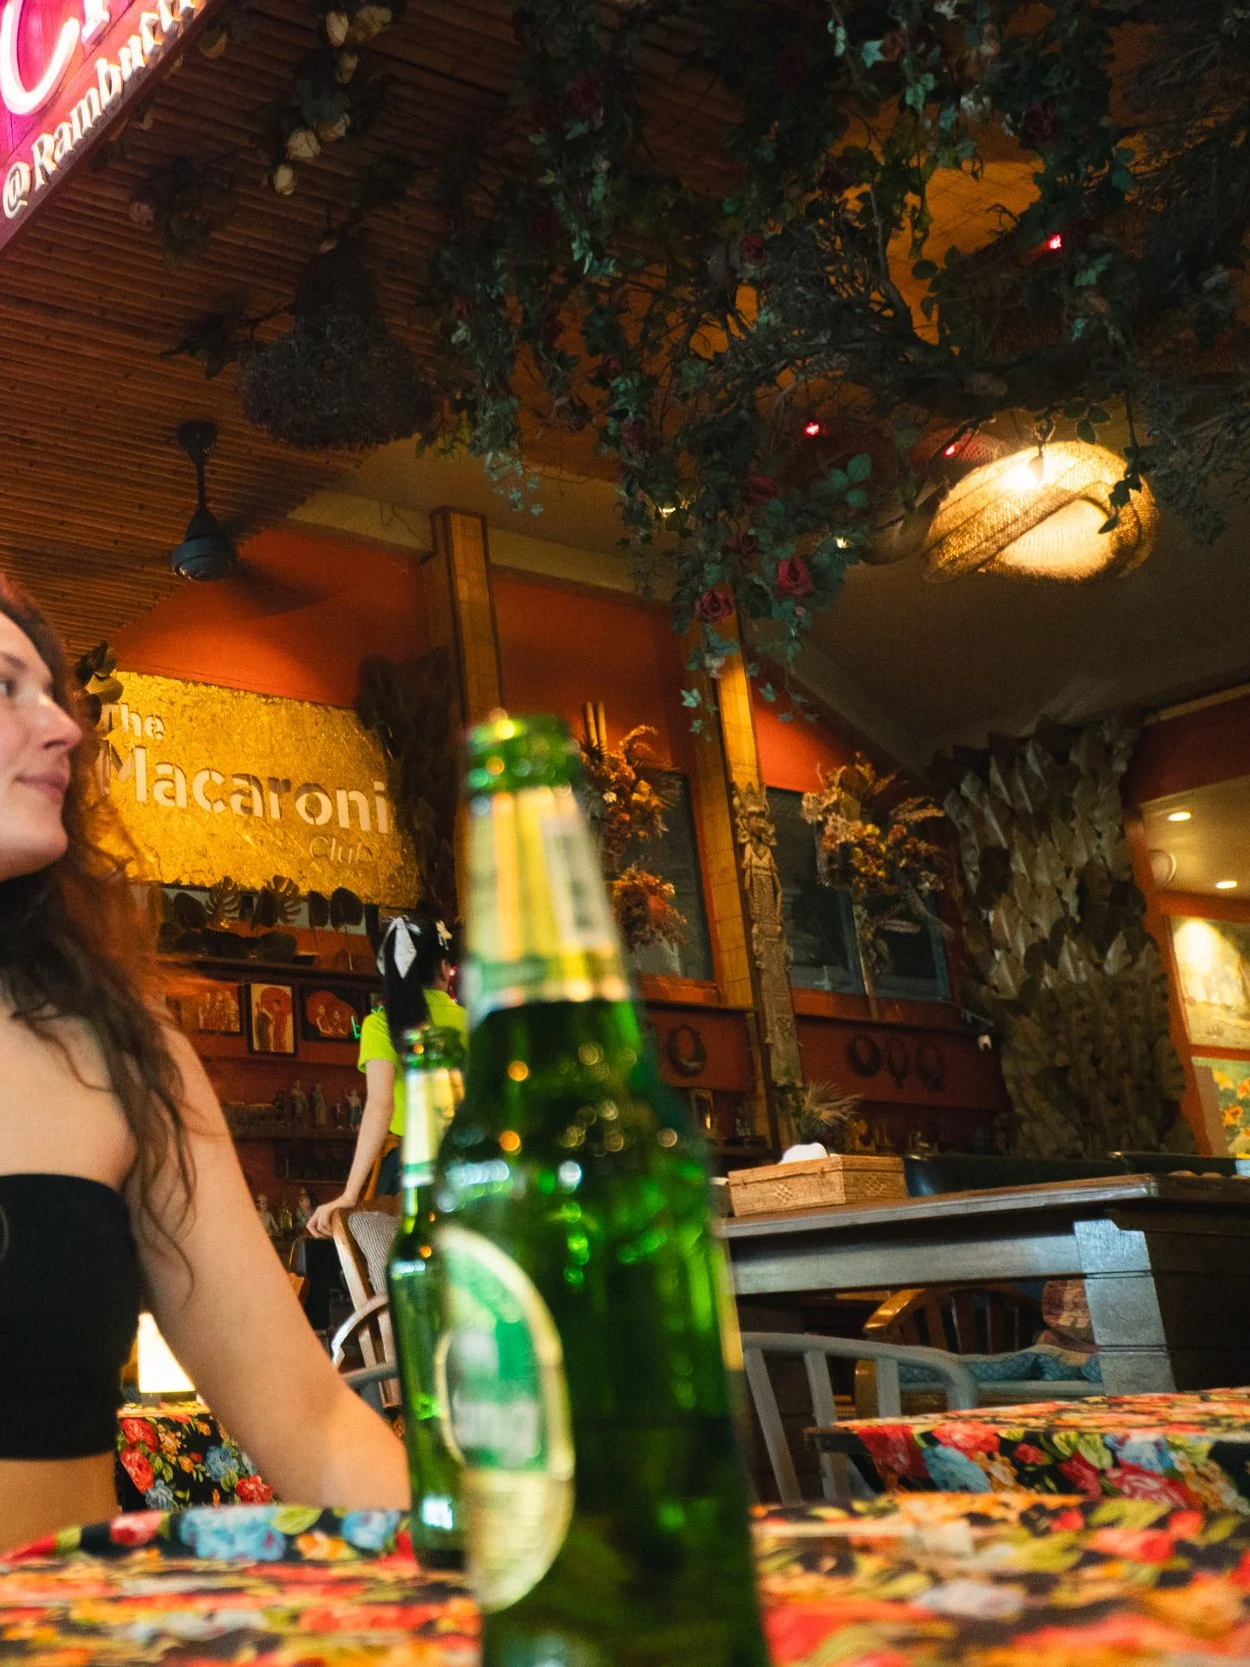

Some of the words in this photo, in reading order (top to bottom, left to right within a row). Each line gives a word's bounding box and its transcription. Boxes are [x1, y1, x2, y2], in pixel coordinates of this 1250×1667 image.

[100, 702, 165, 741] The
[96, 741, 390, 834] Macaroni
[309, 836, 374, 865] Club
